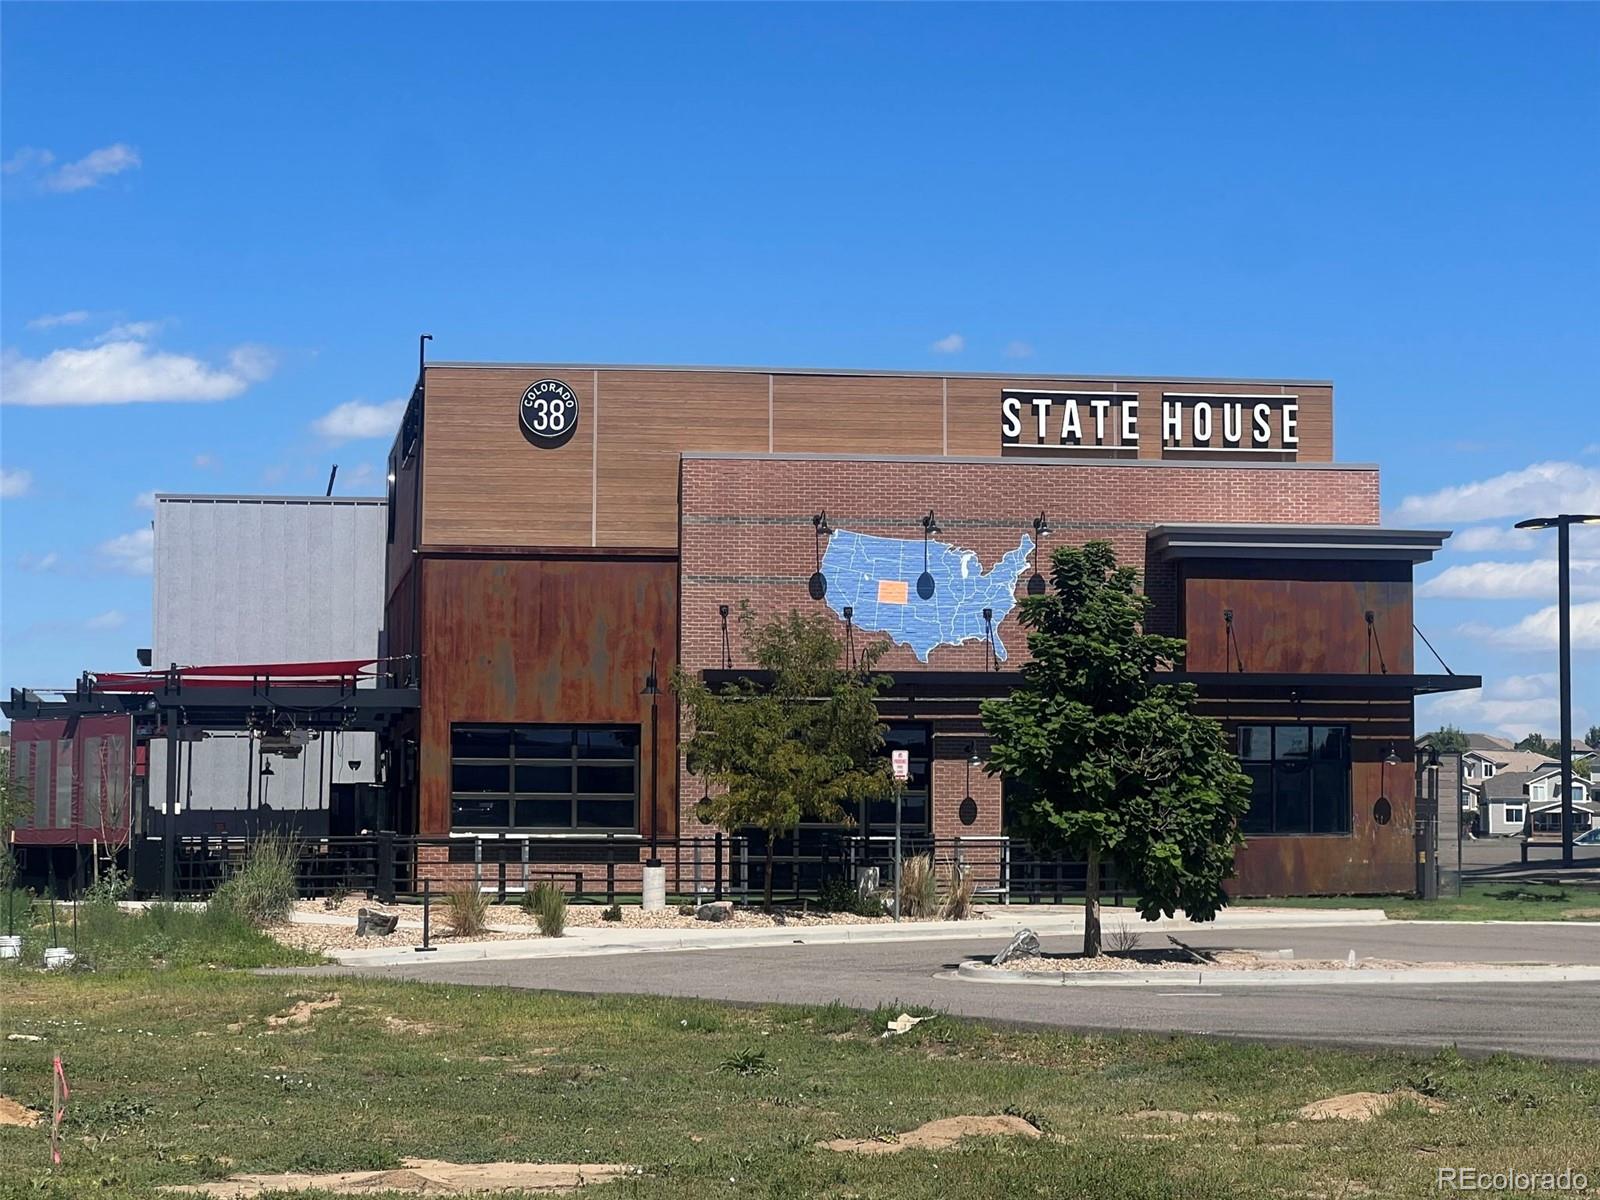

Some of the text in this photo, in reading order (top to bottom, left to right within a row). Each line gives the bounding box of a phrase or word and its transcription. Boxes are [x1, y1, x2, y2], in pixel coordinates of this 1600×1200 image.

[524, 383, 574, 408] COLORADO
[533, 399, 565, 431] 38
[1002, 398, 1299, 443] STATE HOUSE
